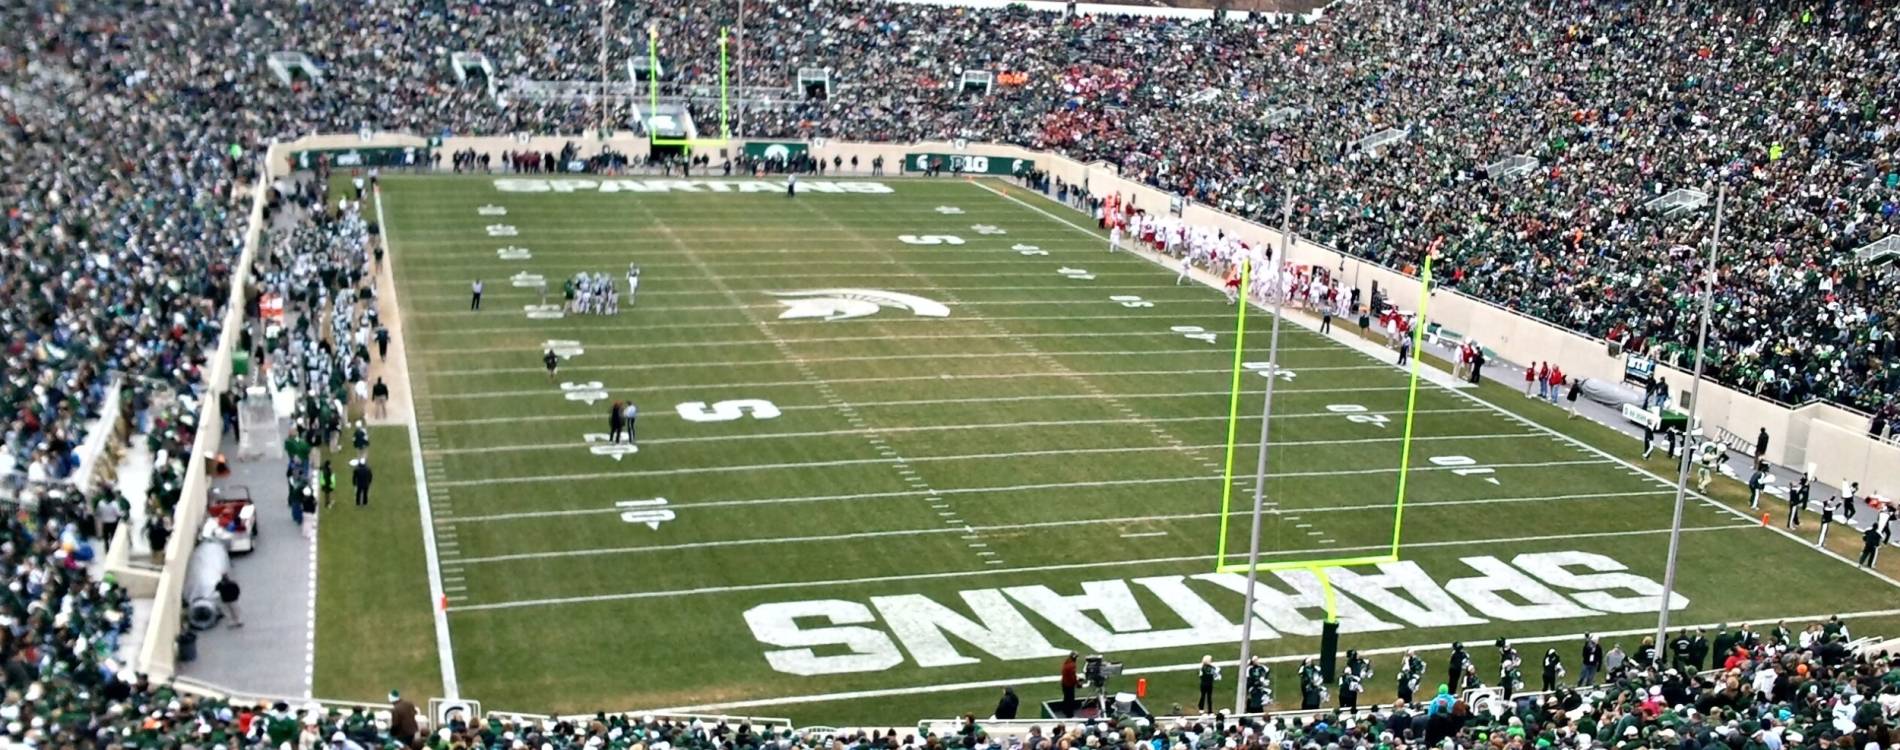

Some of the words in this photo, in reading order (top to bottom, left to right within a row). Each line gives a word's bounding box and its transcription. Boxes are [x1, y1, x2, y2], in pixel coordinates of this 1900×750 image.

[494, 180, 894, 193] SPARTANS
[1326, 405, 1391, 424] 20
[1429, 456, 1496, 476] 10
[615, 498, 676, 522] 10
[742, 550, 1690, 675] SPARTANS
